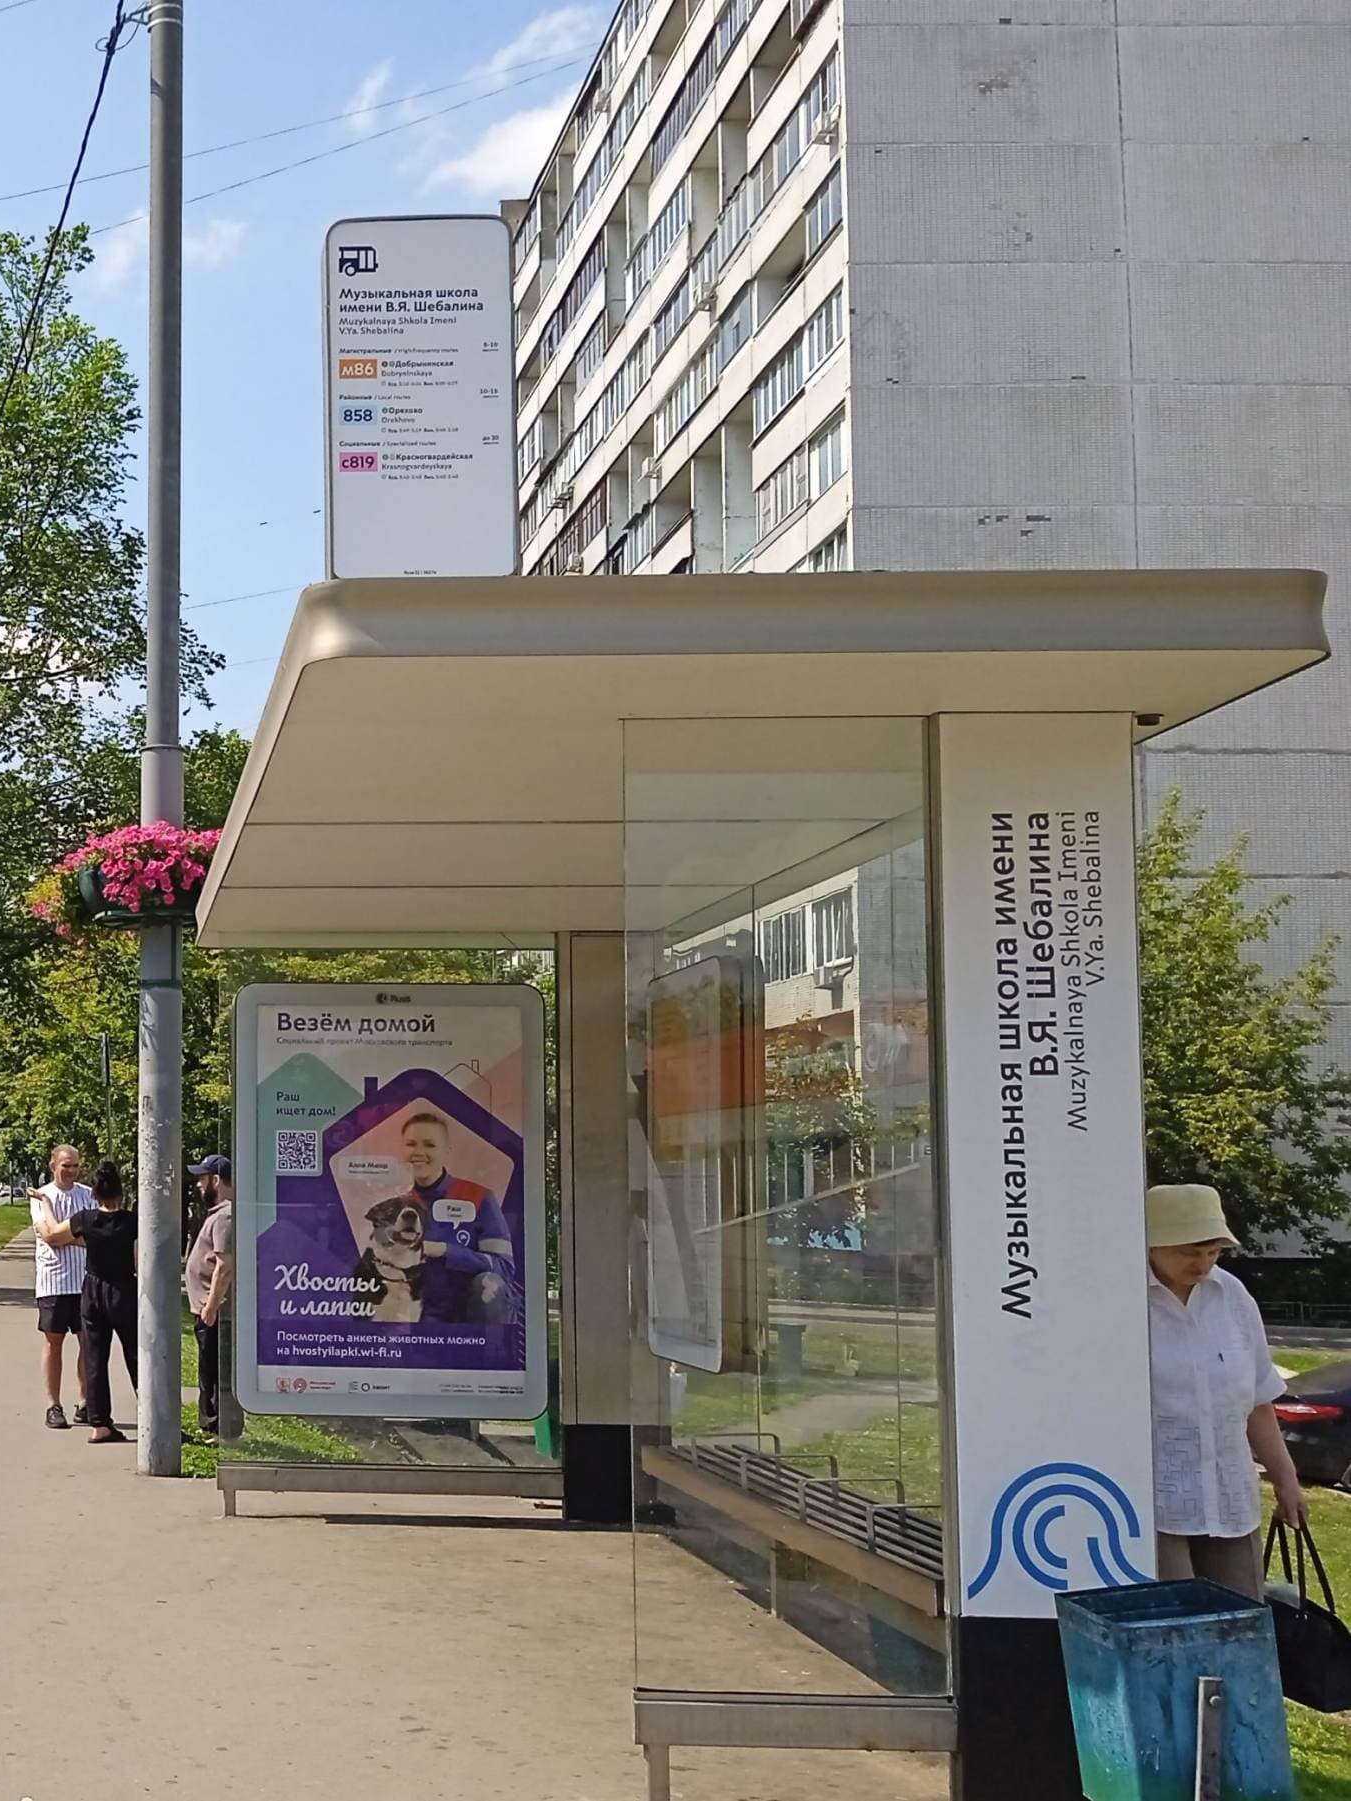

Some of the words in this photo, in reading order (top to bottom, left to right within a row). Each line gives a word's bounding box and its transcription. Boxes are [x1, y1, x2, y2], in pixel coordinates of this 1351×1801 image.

[339, 288, 432, 301] Музыкальная
[436, 288, 478, 298] школа
[339, 303, 382, 313] имени
[386, 302, 410, 313] В.Я.
[414, 300, 484, 312] Шебалина
[339, 317, 397, 326] Muzykalnaya
[399, 317, 428, 325] Shkola
[430, 316, 457, 324] Imeni
[360, 327, 404, 335] Shebalina
[343, 409, 373, 422] 858
[1055, 811, 1078, 882] Imeni
[991, 812, 1018, 926] имени
[1078, 811, 1103, 928] Shebalina
[1023, 812, 1056, 999] Шебалина
[1057, 888, 1081, 967] Shkola
[1084, 934, 1105, 987] V.Ya.
[996, 937, 1021, 1050] школа
[277, 1013, 351, 1032] Везём
[358, 1014, 435, 1034] домой
[1027, 1011, 1059, 1076] В.Я.
[1063, 974, 1090, 1131] Muzykalnaya
[276, 1091, 300, 1102] Раш
[276, 1106, 306, 1117] ищет
[308, 1105, 336, 1118] дом!
[1000, 1062, 1039, 1319] Музыкальная
[274, 1263, 380, 1293] Хвосты
[280, 1300, 297, 1316] и
[300, 1299, 376, 1318] лапки
[277, 1331, 345, 1344] Посмотреть
[347, 1334, 386, 1344] анкеты
[388, 1335, 445, 1345] животных
[447, 1336, 486, 1346] можно
[277, 1347, 290, 1356] на
[292, 1346, 402, 1359] hvostyilapki.wi-fi.ru
